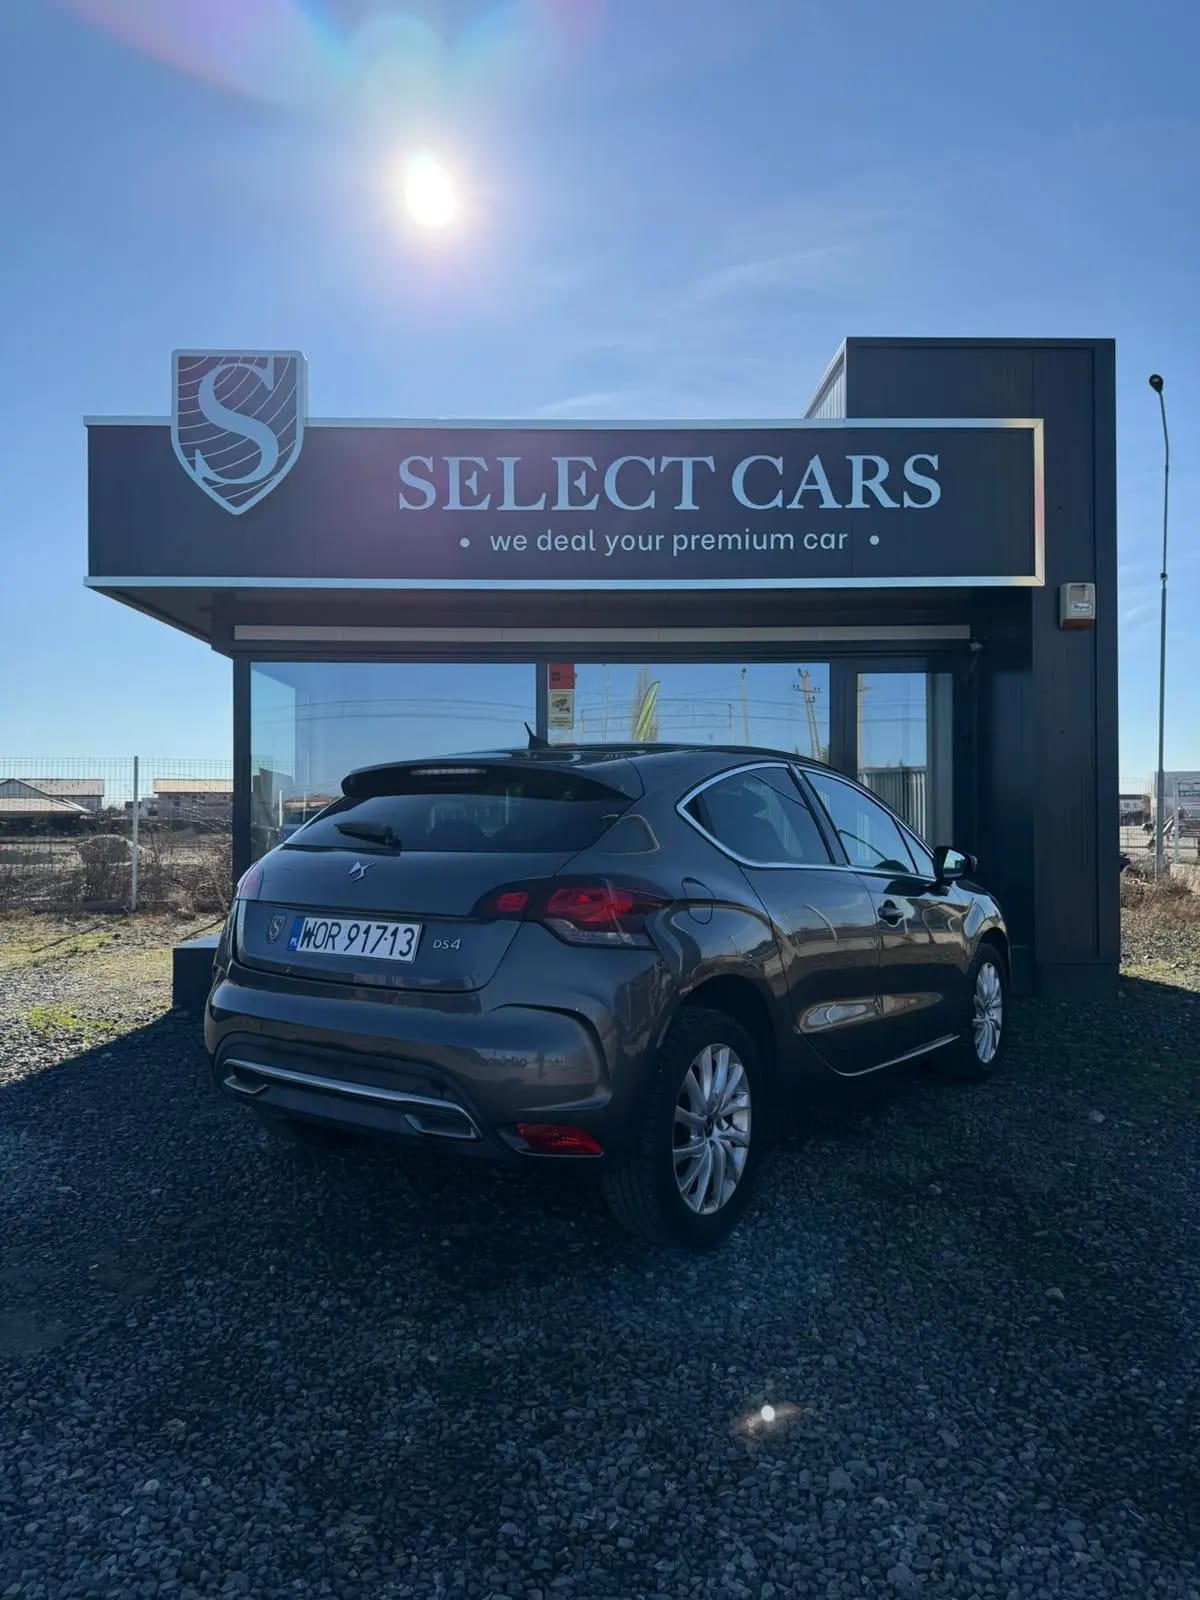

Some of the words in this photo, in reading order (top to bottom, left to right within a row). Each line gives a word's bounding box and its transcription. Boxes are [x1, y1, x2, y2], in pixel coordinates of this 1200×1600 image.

[195, 362, 279, 485] S
[398, 455, 715, 511] SELECT
[732, 453, 942, 510] CARS
[489, 534, 528, 552] we
[536, 529, 597, 552] deal
[604, 533, 665, 557] your
[673, 528, 794, 557] premium
[803, 533, 848, 550] car
[300, 918, 342, 951] WOR
[343, 922, 416, 957] 91713
[432, 938, 462, 952] DS4
